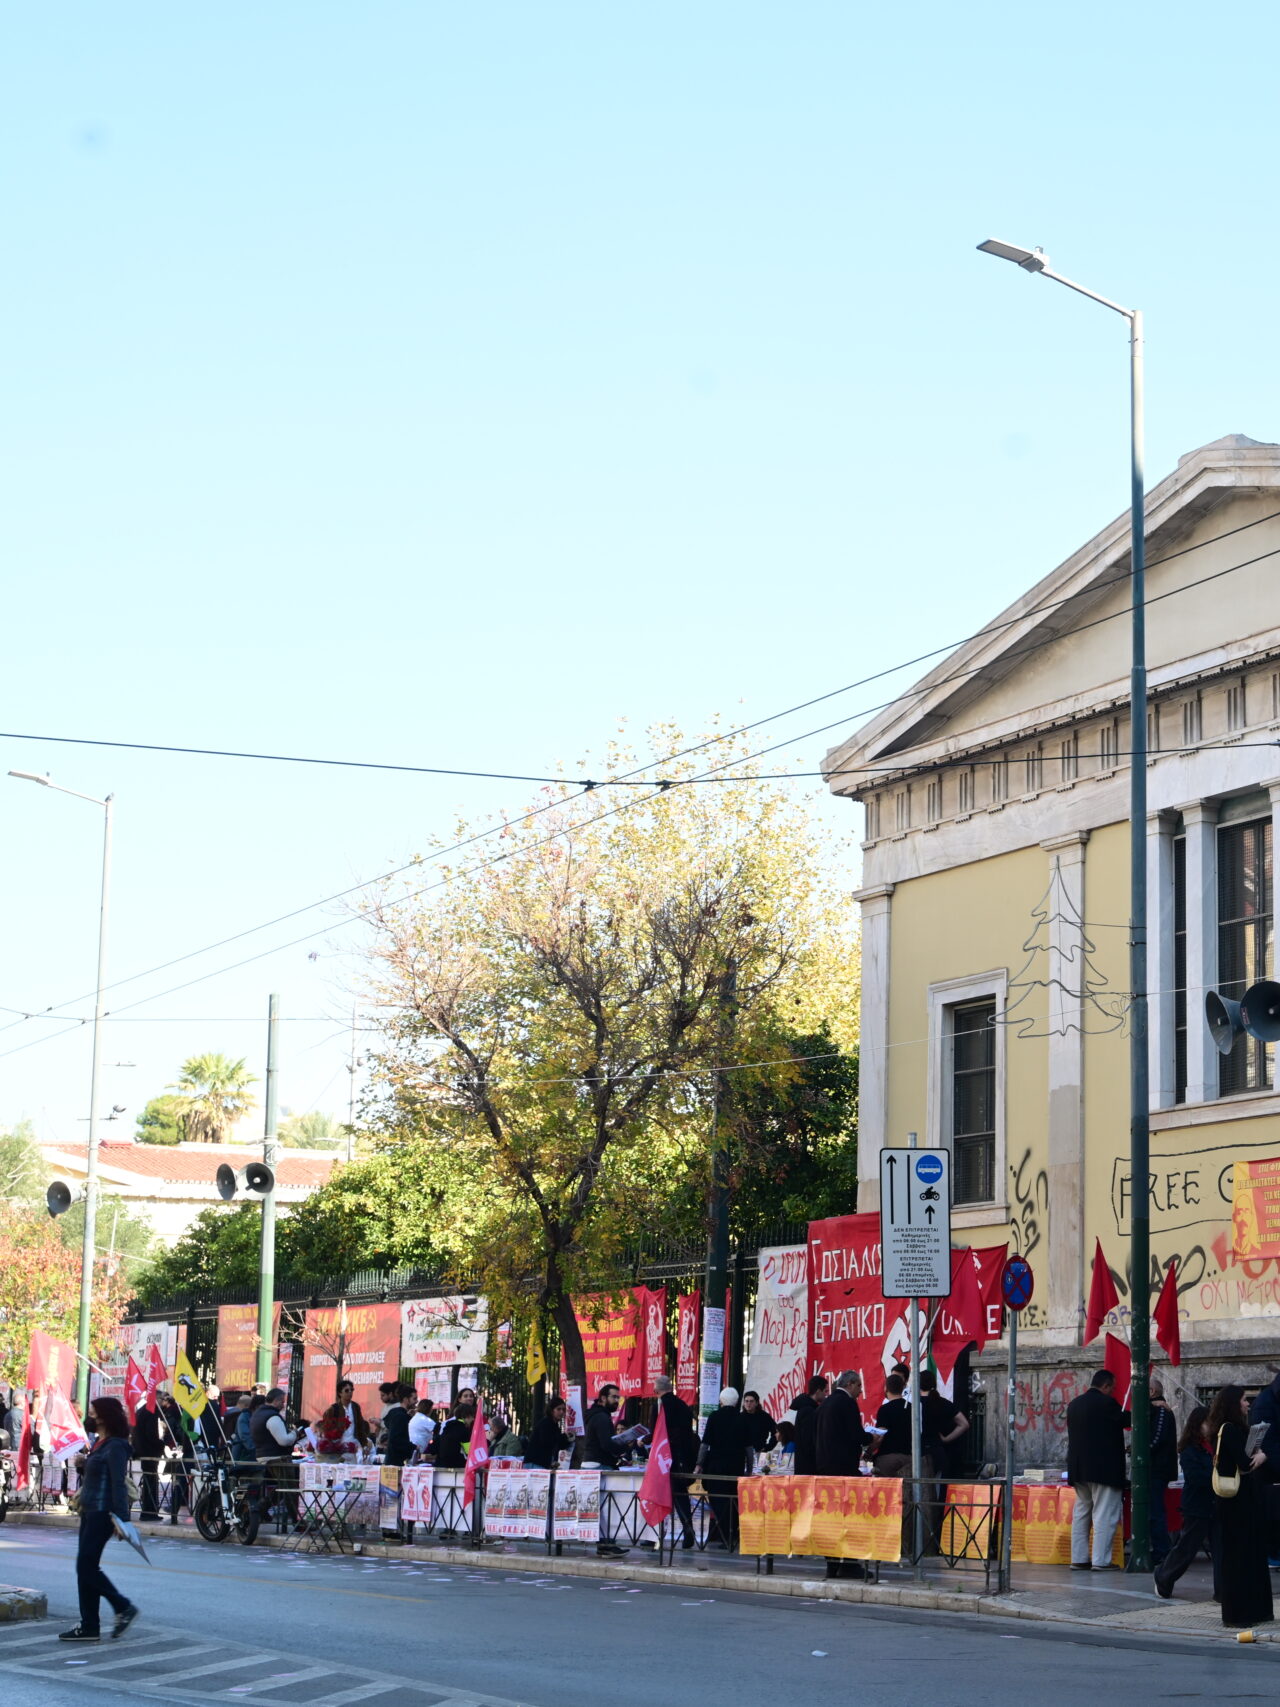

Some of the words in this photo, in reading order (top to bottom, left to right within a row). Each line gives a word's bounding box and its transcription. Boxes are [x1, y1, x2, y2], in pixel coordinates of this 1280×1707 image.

[778, 1250, 808, 1284] ΔΡΟΜ
[759, 1307, 808, 1358] Νοεμβρ
[813, 1295, 885, 1344] ΕΡΓΑΤΙΚΟ
